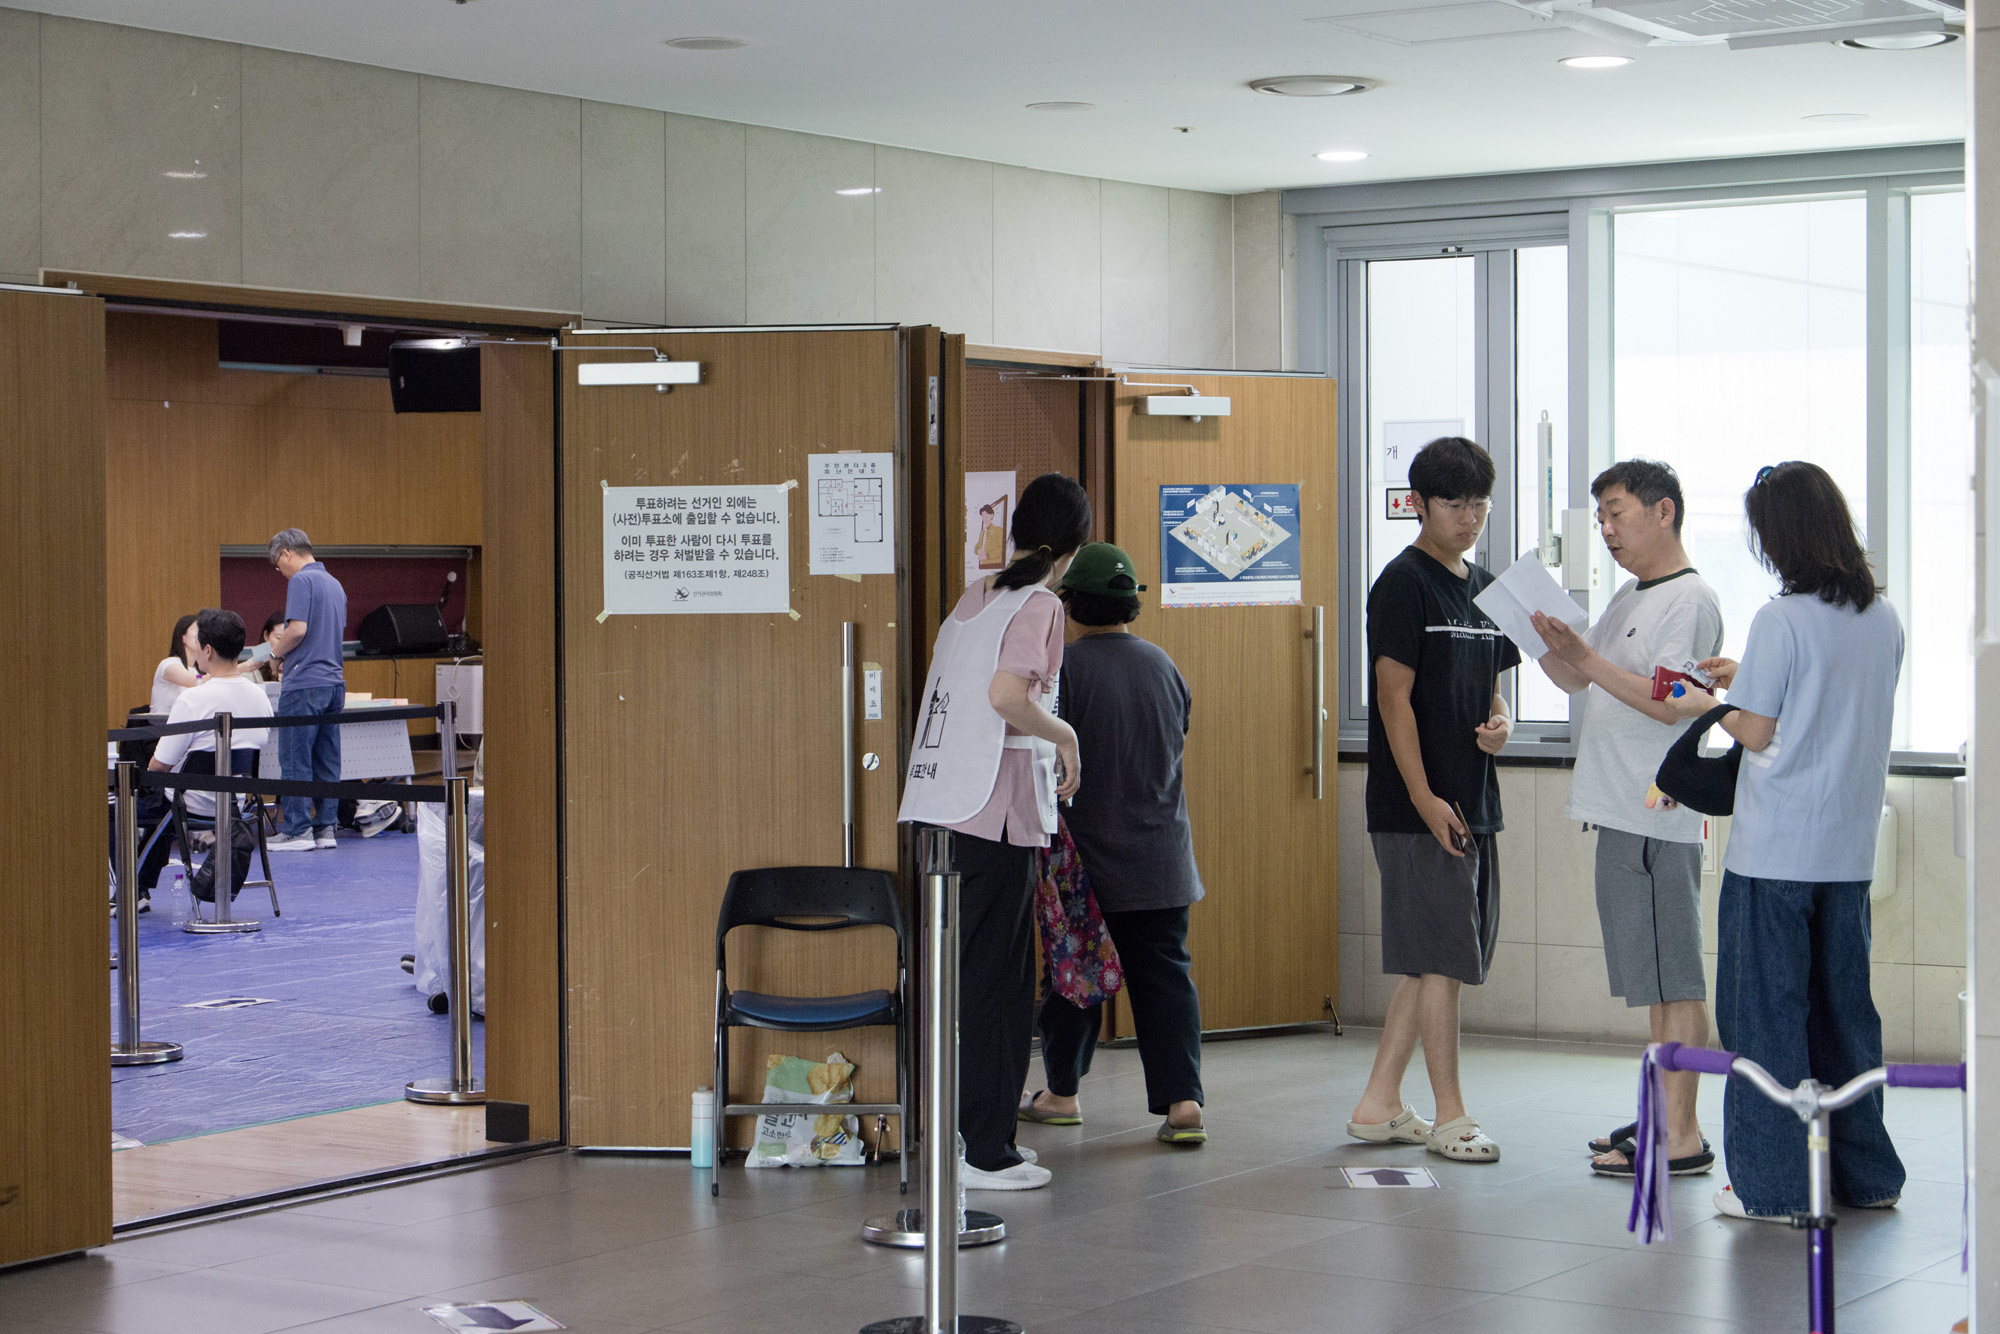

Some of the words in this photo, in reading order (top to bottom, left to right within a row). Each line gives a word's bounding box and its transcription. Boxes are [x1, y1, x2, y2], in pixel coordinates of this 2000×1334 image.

[636, 496, 687, 511] 투표하려는
[691, 496, 722, 510] 선거인
[726, 495, 757, 509] 외에는
[612, 512, 682, 526] (사전)투표소에
[686, 512, 717, 525] 출입할
[721, 512, 731, 525] 수
[735, 511, 780, 524] 없습니다.
[621, 534, 641, 548] 이미
[645, 534, 677, 547] 투표한
[681, 533, 711, 547] 사람이
[716, 533, 736, 547] 다시
[741, 533, 772, 546] 투표를
[614, 549, 645, 563] 하려는
[649, 549, 669, 562] 경우
[674, 548, 715, 562] 처벌받을
[719, 548, 729, 561] 수
[734, 547, 779, 561] 있습니다.
[625, 569, 669, 580] (공직선거법
[673, 569, 730, 580] 제163조제1항,
[733, 568, 769, 579] 제248조)
